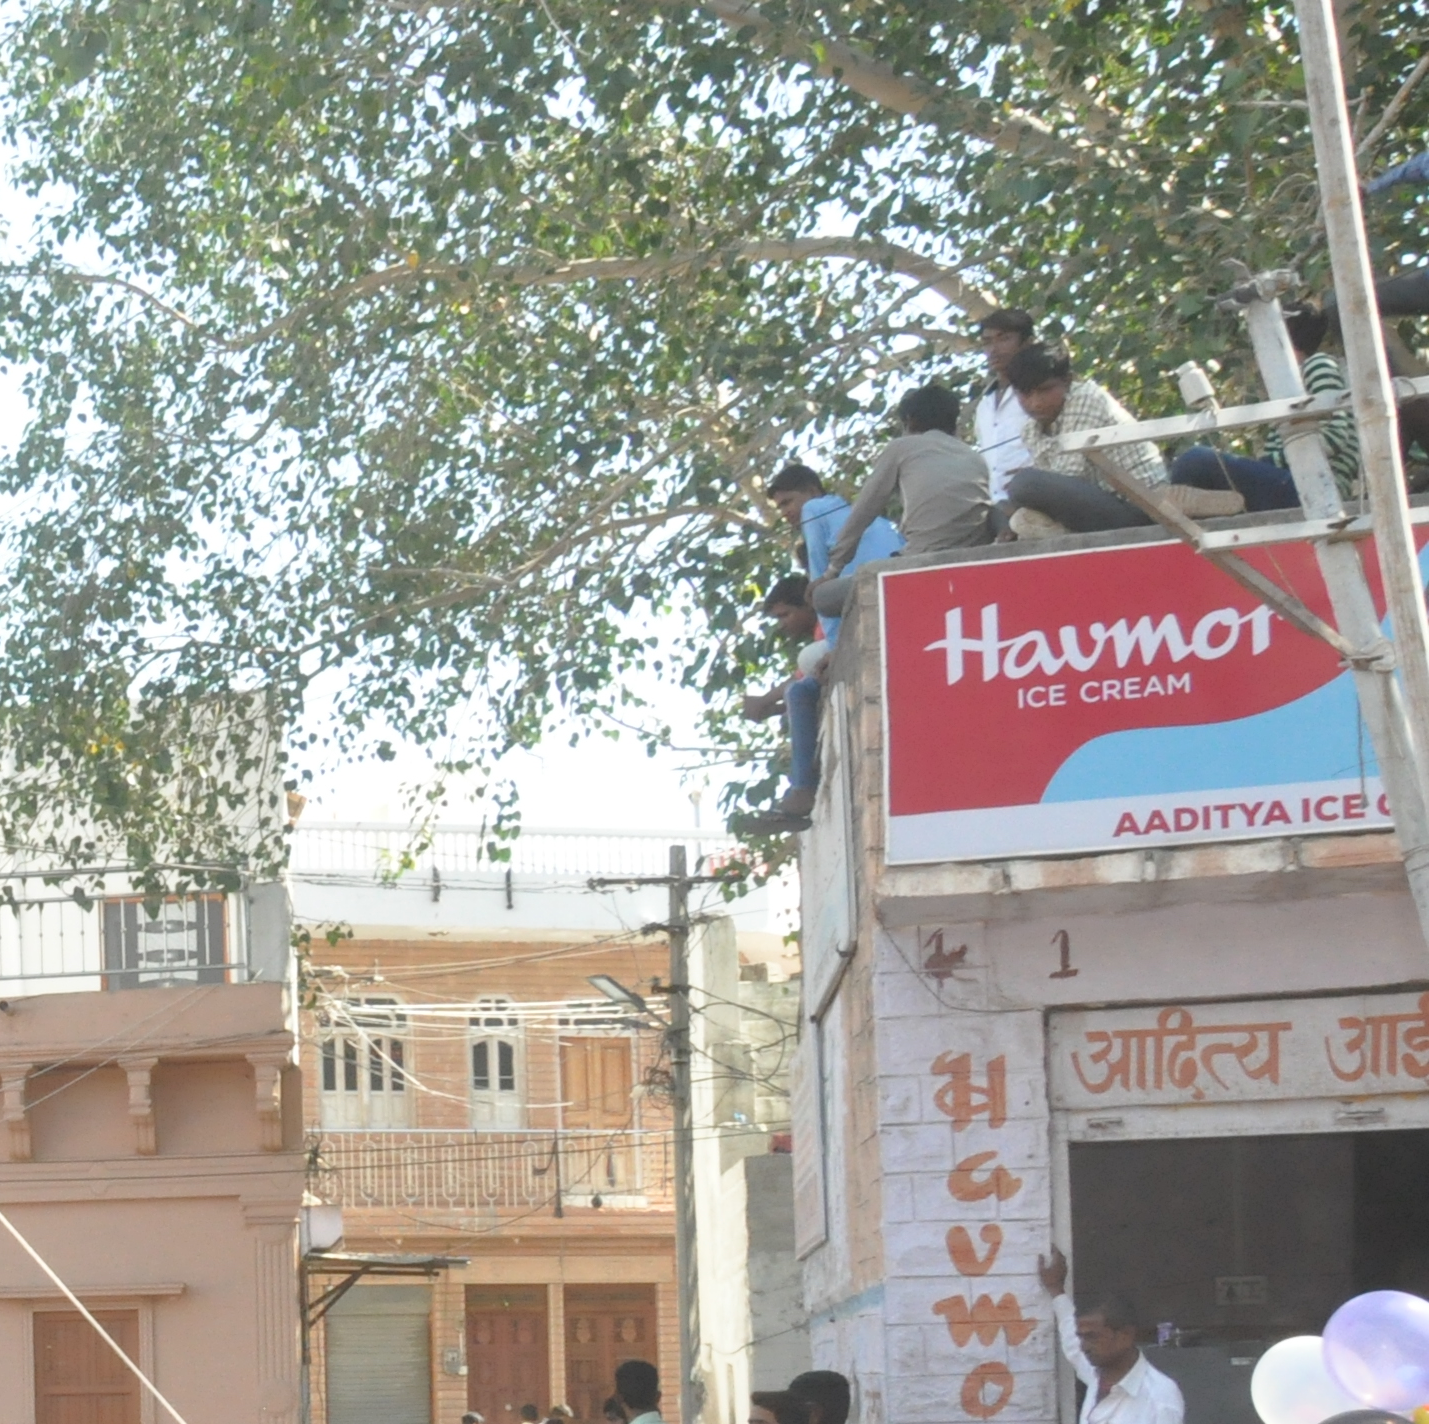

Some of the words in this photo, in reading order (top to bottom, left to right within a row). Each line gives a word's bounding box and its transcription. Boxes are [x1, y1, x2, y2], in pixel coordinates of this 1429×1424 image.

[924, 603, 1286, 686] Havmor
[1017, 684, 1067, 709] ICE
[1079, 672, 1191, 704] CREAM
[1113, 799, 1292, 838] AADITYA
[1301, 794, 1366, 823] ICE
[1048, 928, 1081, 980] 1
[1071, 1006, 1292, 1101] आदित्य
